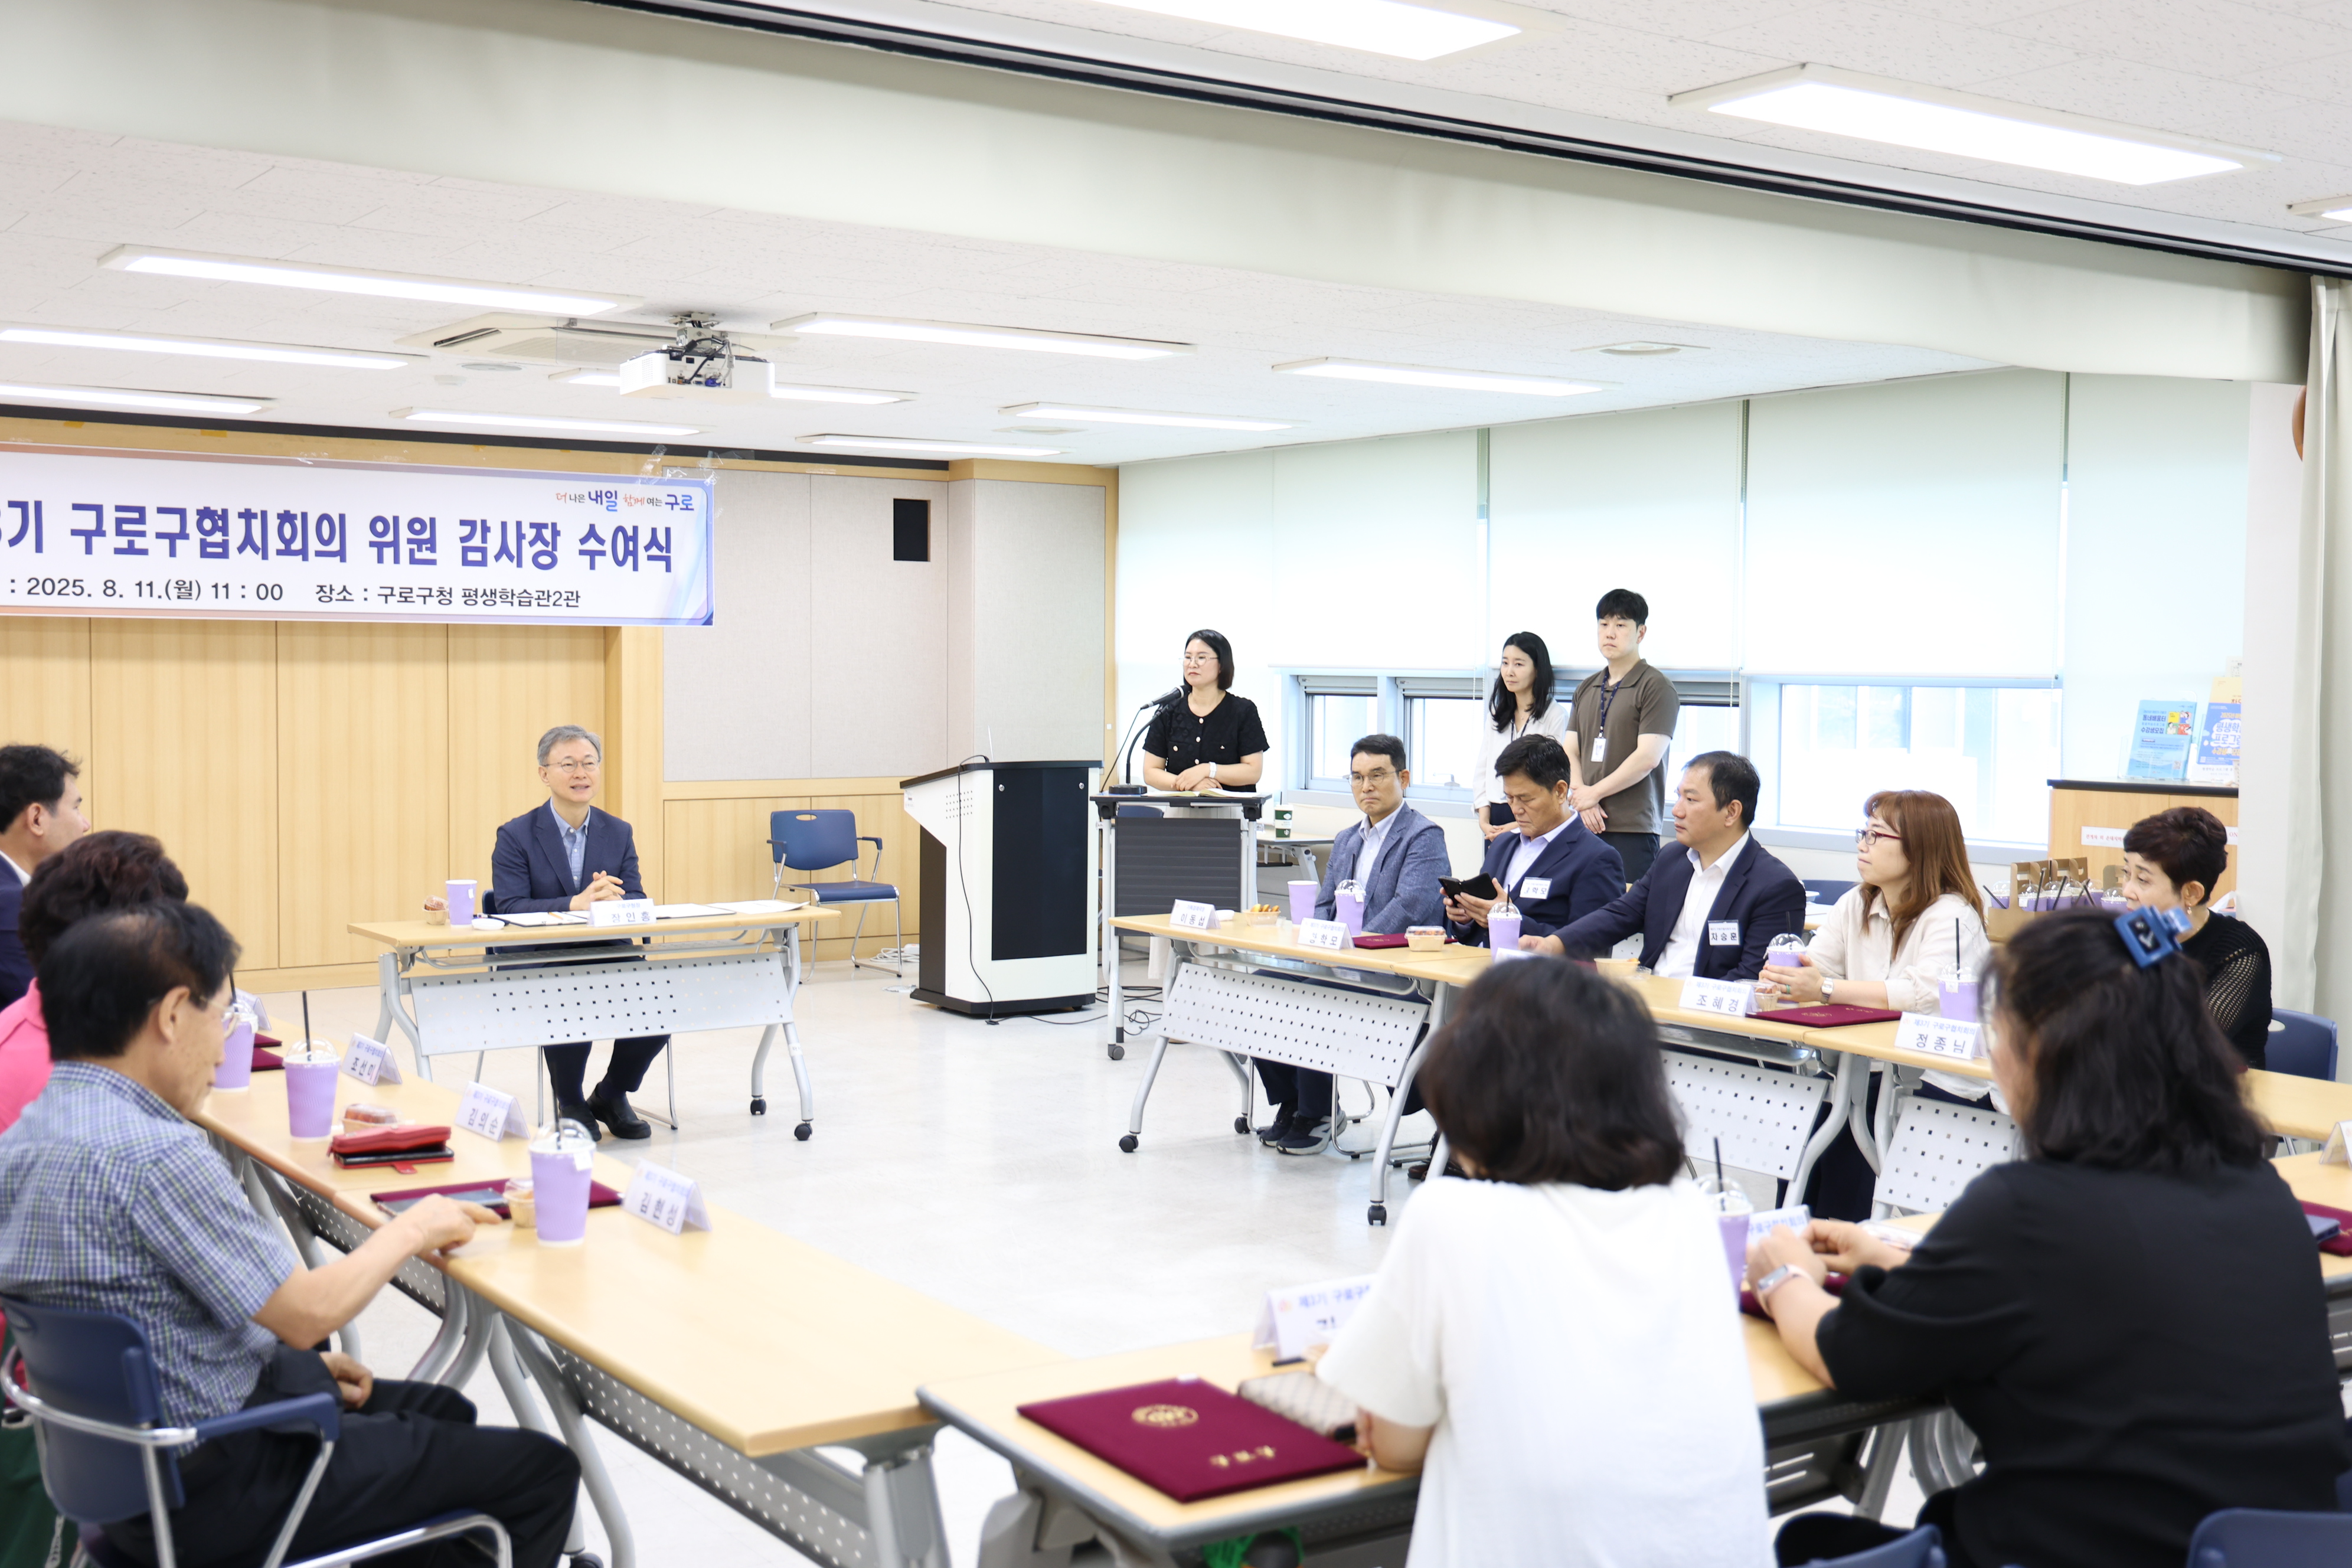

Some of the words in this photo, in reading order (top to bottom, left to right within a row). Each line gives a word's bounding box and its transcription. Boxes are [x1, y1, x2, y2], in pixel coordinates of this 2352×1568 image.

[556, 492, 567, 504] 더
[569, 494, 586, 503] 나은
[588, 490, 618, 512] 내일
[623, 494, 645, 507] 함께
[646, 497, 662, 507] 여는
[665, 494, 694, 511] 구로
[0, 499, 43, 554] 기
[70, 502, 347, 563] 구로구협치회의
[368, 515, 437, 566] 위원
[458, 518, 561, 571] 감사장
[578, 523, 672, 573] 수여식
[27, 577, 92, 597] 2025.
[103, 579, 123, 598] 8.
[315, 584, 354, 603] 장소
[377, 587, 453, 606] 구로구청
[461, 589, 581, 607] 평생학습관2관
[2216, 722, 2241, 733] 평생학
[612, 911, 650, 923] 장인홍
[1181, 913, 1206, 926] 이동섭
[1696, 994, 1739, 1012] 조혜경
[1914, 1019, 1930, 1027] 제3기
[1932, 1021, 1976, 1035] 구로구협치회의
[1916, 1033, 1966, 1054] 정종님
[351, 1057, 375, 1080] 조선미
[468, 1108, 498, 1135] 김의순
